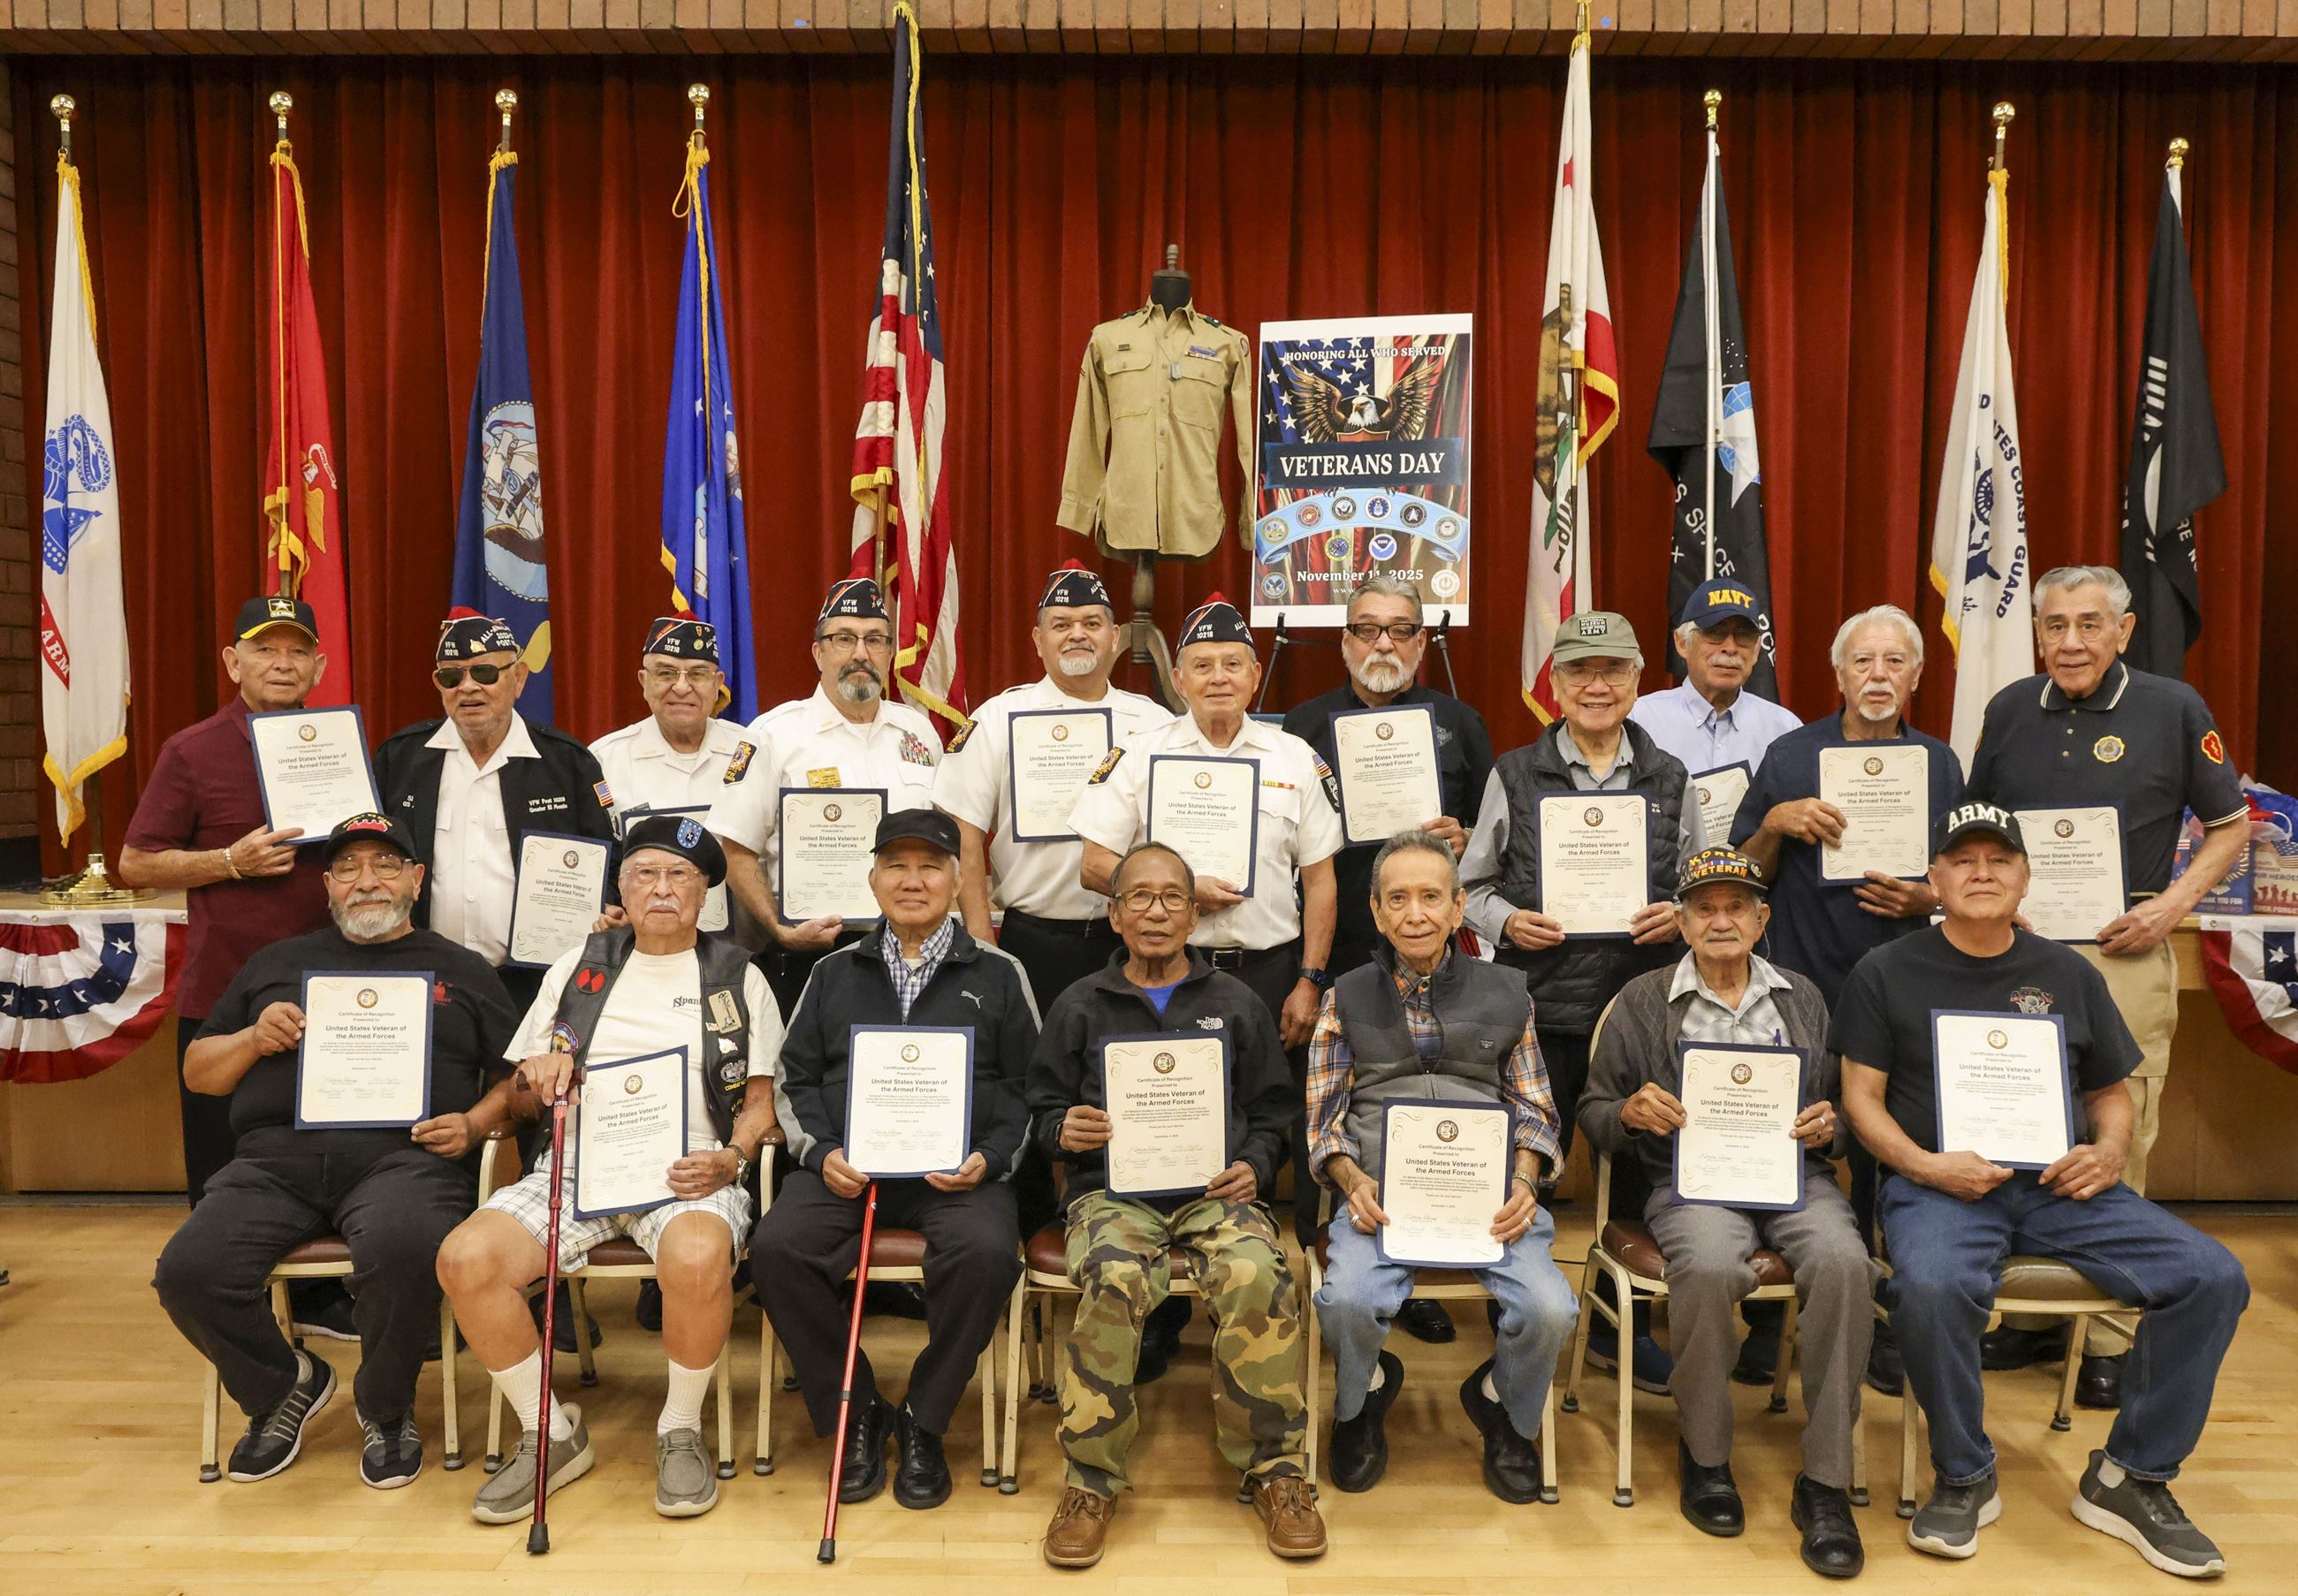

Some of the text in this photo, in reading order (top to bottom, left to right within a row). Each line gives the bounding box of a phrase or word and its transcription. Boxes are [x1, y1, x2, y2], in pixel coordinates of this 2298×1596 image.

[1286, 346, 1446, 361] HONORING ALL WHO SERVED
[1280, 452, 1445, 477] VETERANS DAY
[1995, 466, 2027, 619] COAST GUARD
[1297, 570, 1364, 581] November
[1389, 569, 1423, 580] 2025
[1708, 589, 1753, 609] NAVY
[1197, 631, 1213, 639] 10218
[42, 630, 70, 678] ARM
[1948, 803, 2010, 834] ARMY
[1693, 865, 1747, 879] VETERAN
[599, 1113, 617, 1121] United
[638, 1106, 660, 1114] Veteran
[619, 1117, 637, 1126] Armed
[639, 1114, 658, 1122] Forces
